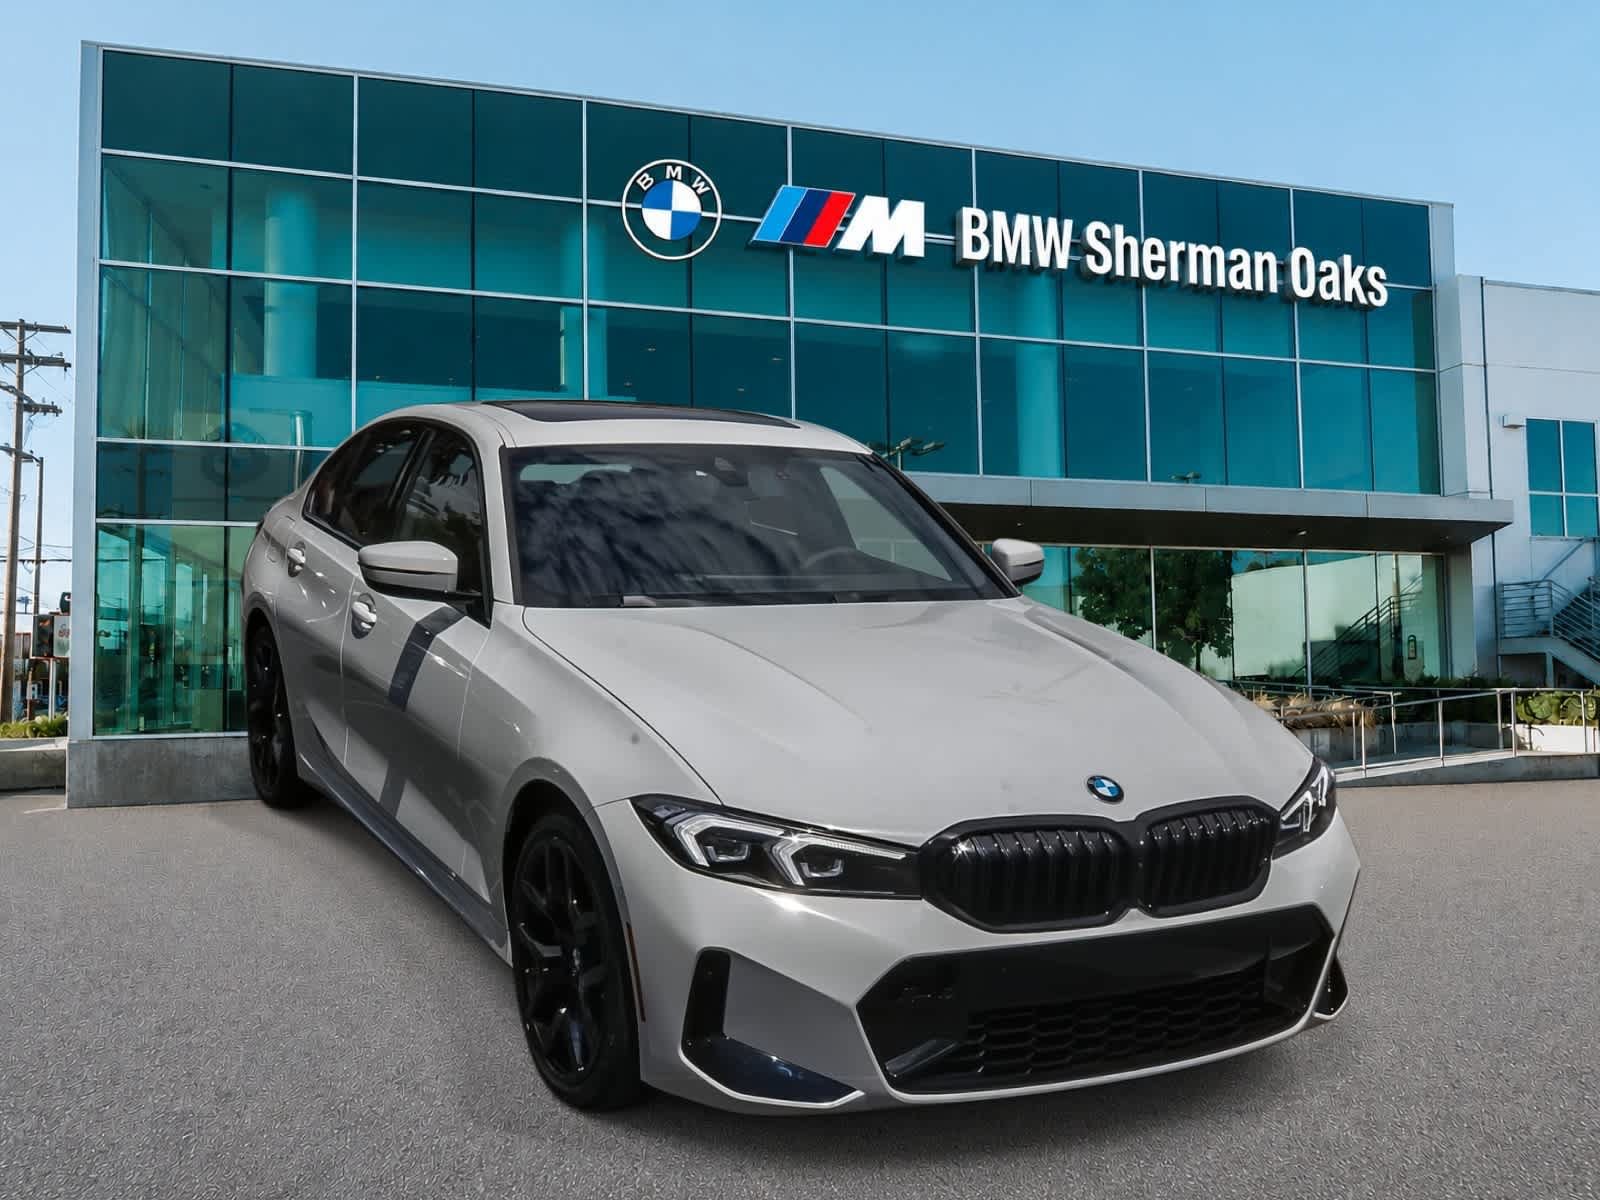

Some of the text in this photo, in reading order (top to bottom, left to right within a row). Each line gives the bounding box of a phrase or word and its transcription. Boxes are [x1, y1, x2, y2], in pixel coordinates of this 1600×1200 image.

[636, 165, 711, 193] BMW
[836, 195, 925, 257] M
[960, 207, 1388, 307] BMW Sherman Oaks
